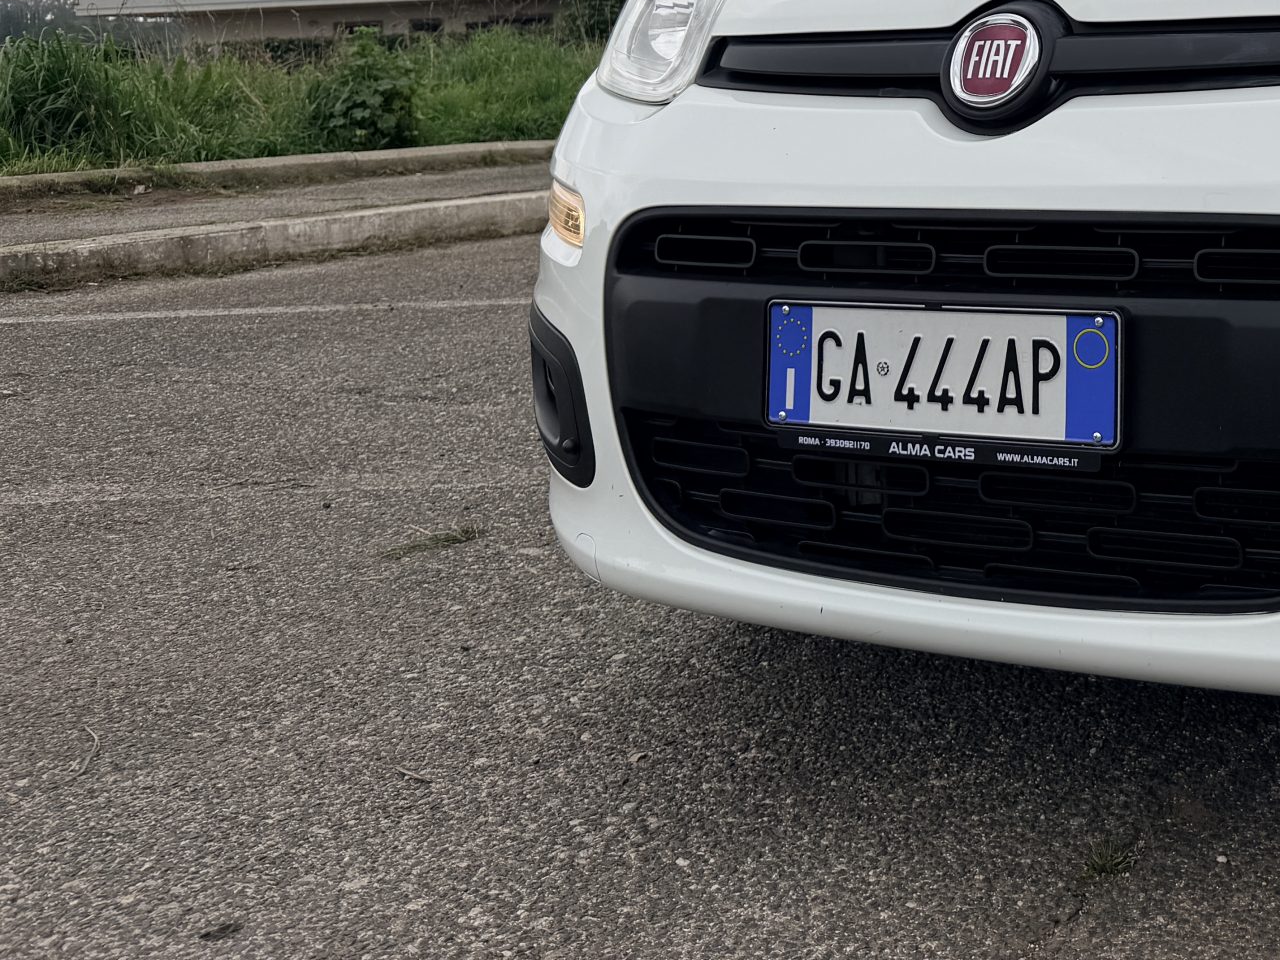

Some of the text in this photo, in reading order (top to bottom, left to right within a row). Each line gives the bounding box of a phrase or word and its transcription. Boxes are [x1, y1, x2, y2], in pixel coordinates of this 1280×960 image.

[966, 39, 1022, 79] FIAT
[785, 367, 796, 410] I
[798, 436, 820, 446] ROMA
[825, 438, 871, 450] 3930921170
[888, 441, 975, 460] ALMA CARS
[996, 452, 1079, 467] WWW.ALMACARS.IT
